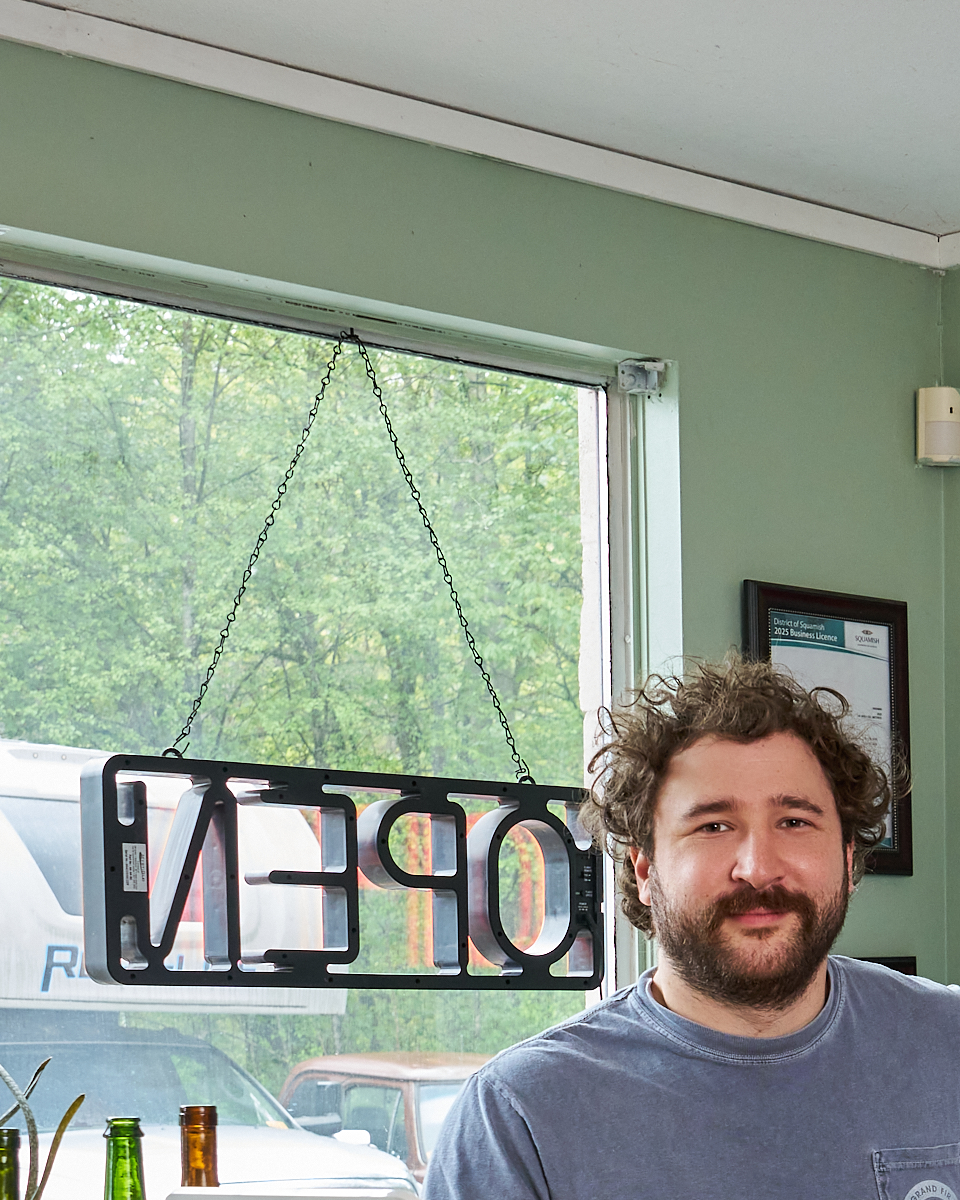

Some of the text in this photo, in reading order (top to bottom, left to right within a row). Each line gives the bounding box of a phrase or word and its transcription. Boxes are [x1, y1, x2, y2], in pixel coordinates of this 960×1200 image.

[774, 618, 793, 628] District
[799, 621, 825, 631] Squamish
[774, 627, 838, 642] 2025 Business Licence
[855, 636, 879, 644] SQUAMISH
[941, 1188, 951, 1199] FIR
